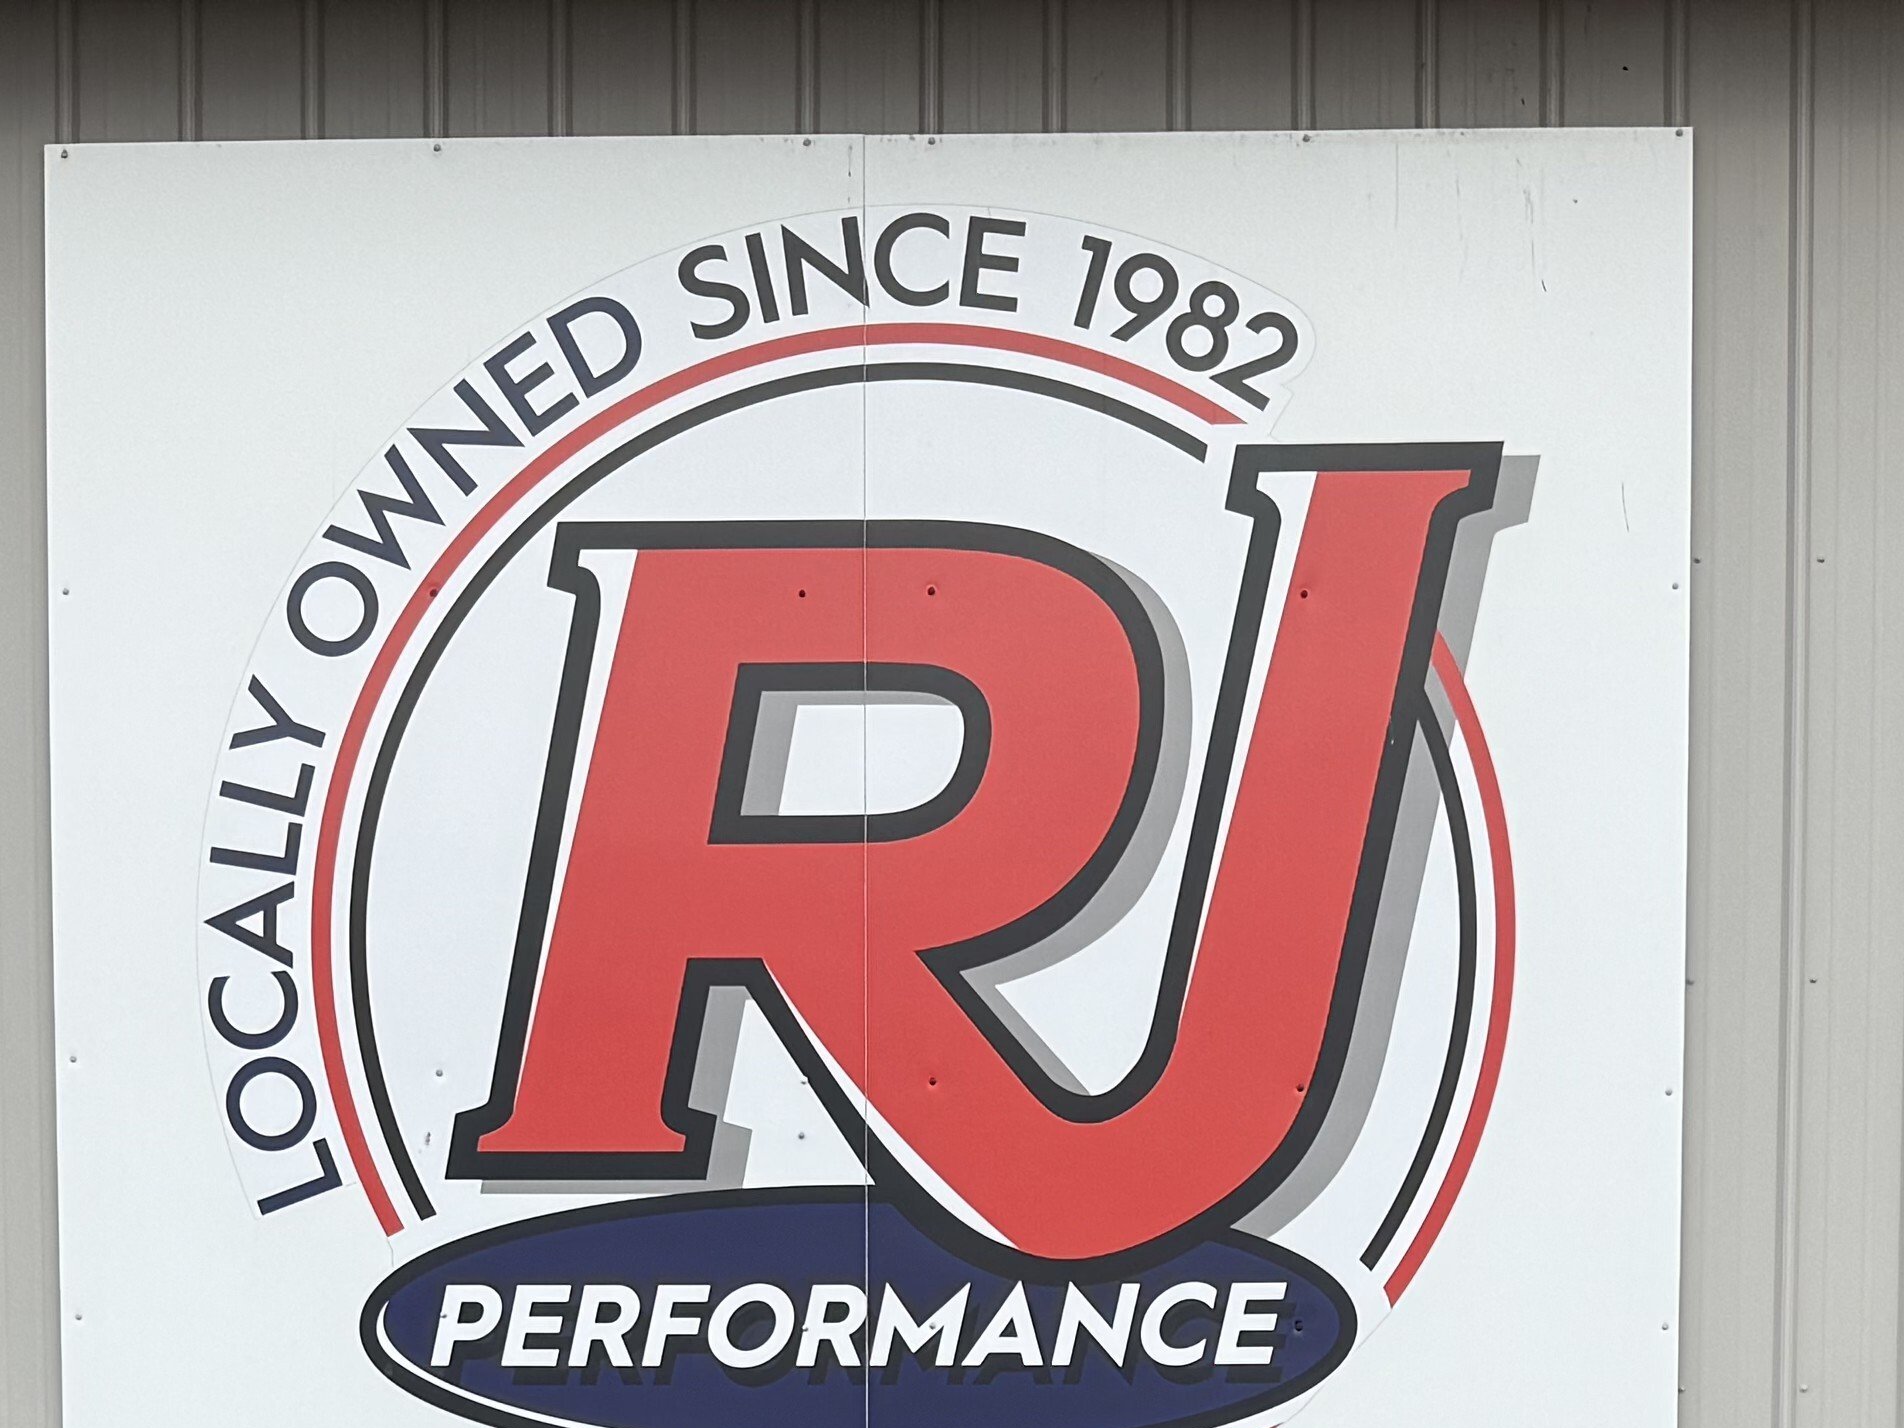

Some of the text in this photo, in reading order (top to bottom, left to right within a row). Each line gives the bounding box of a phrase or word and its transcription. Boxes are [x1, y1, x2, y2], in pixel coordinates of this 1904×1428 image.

[203, 212, 1299, 1216] LOCALLY OWNED SINCE 1982
[444, 440, 1506, 1288] RJ
[429, 1280, 1290, 1369] PERFORMANCE
